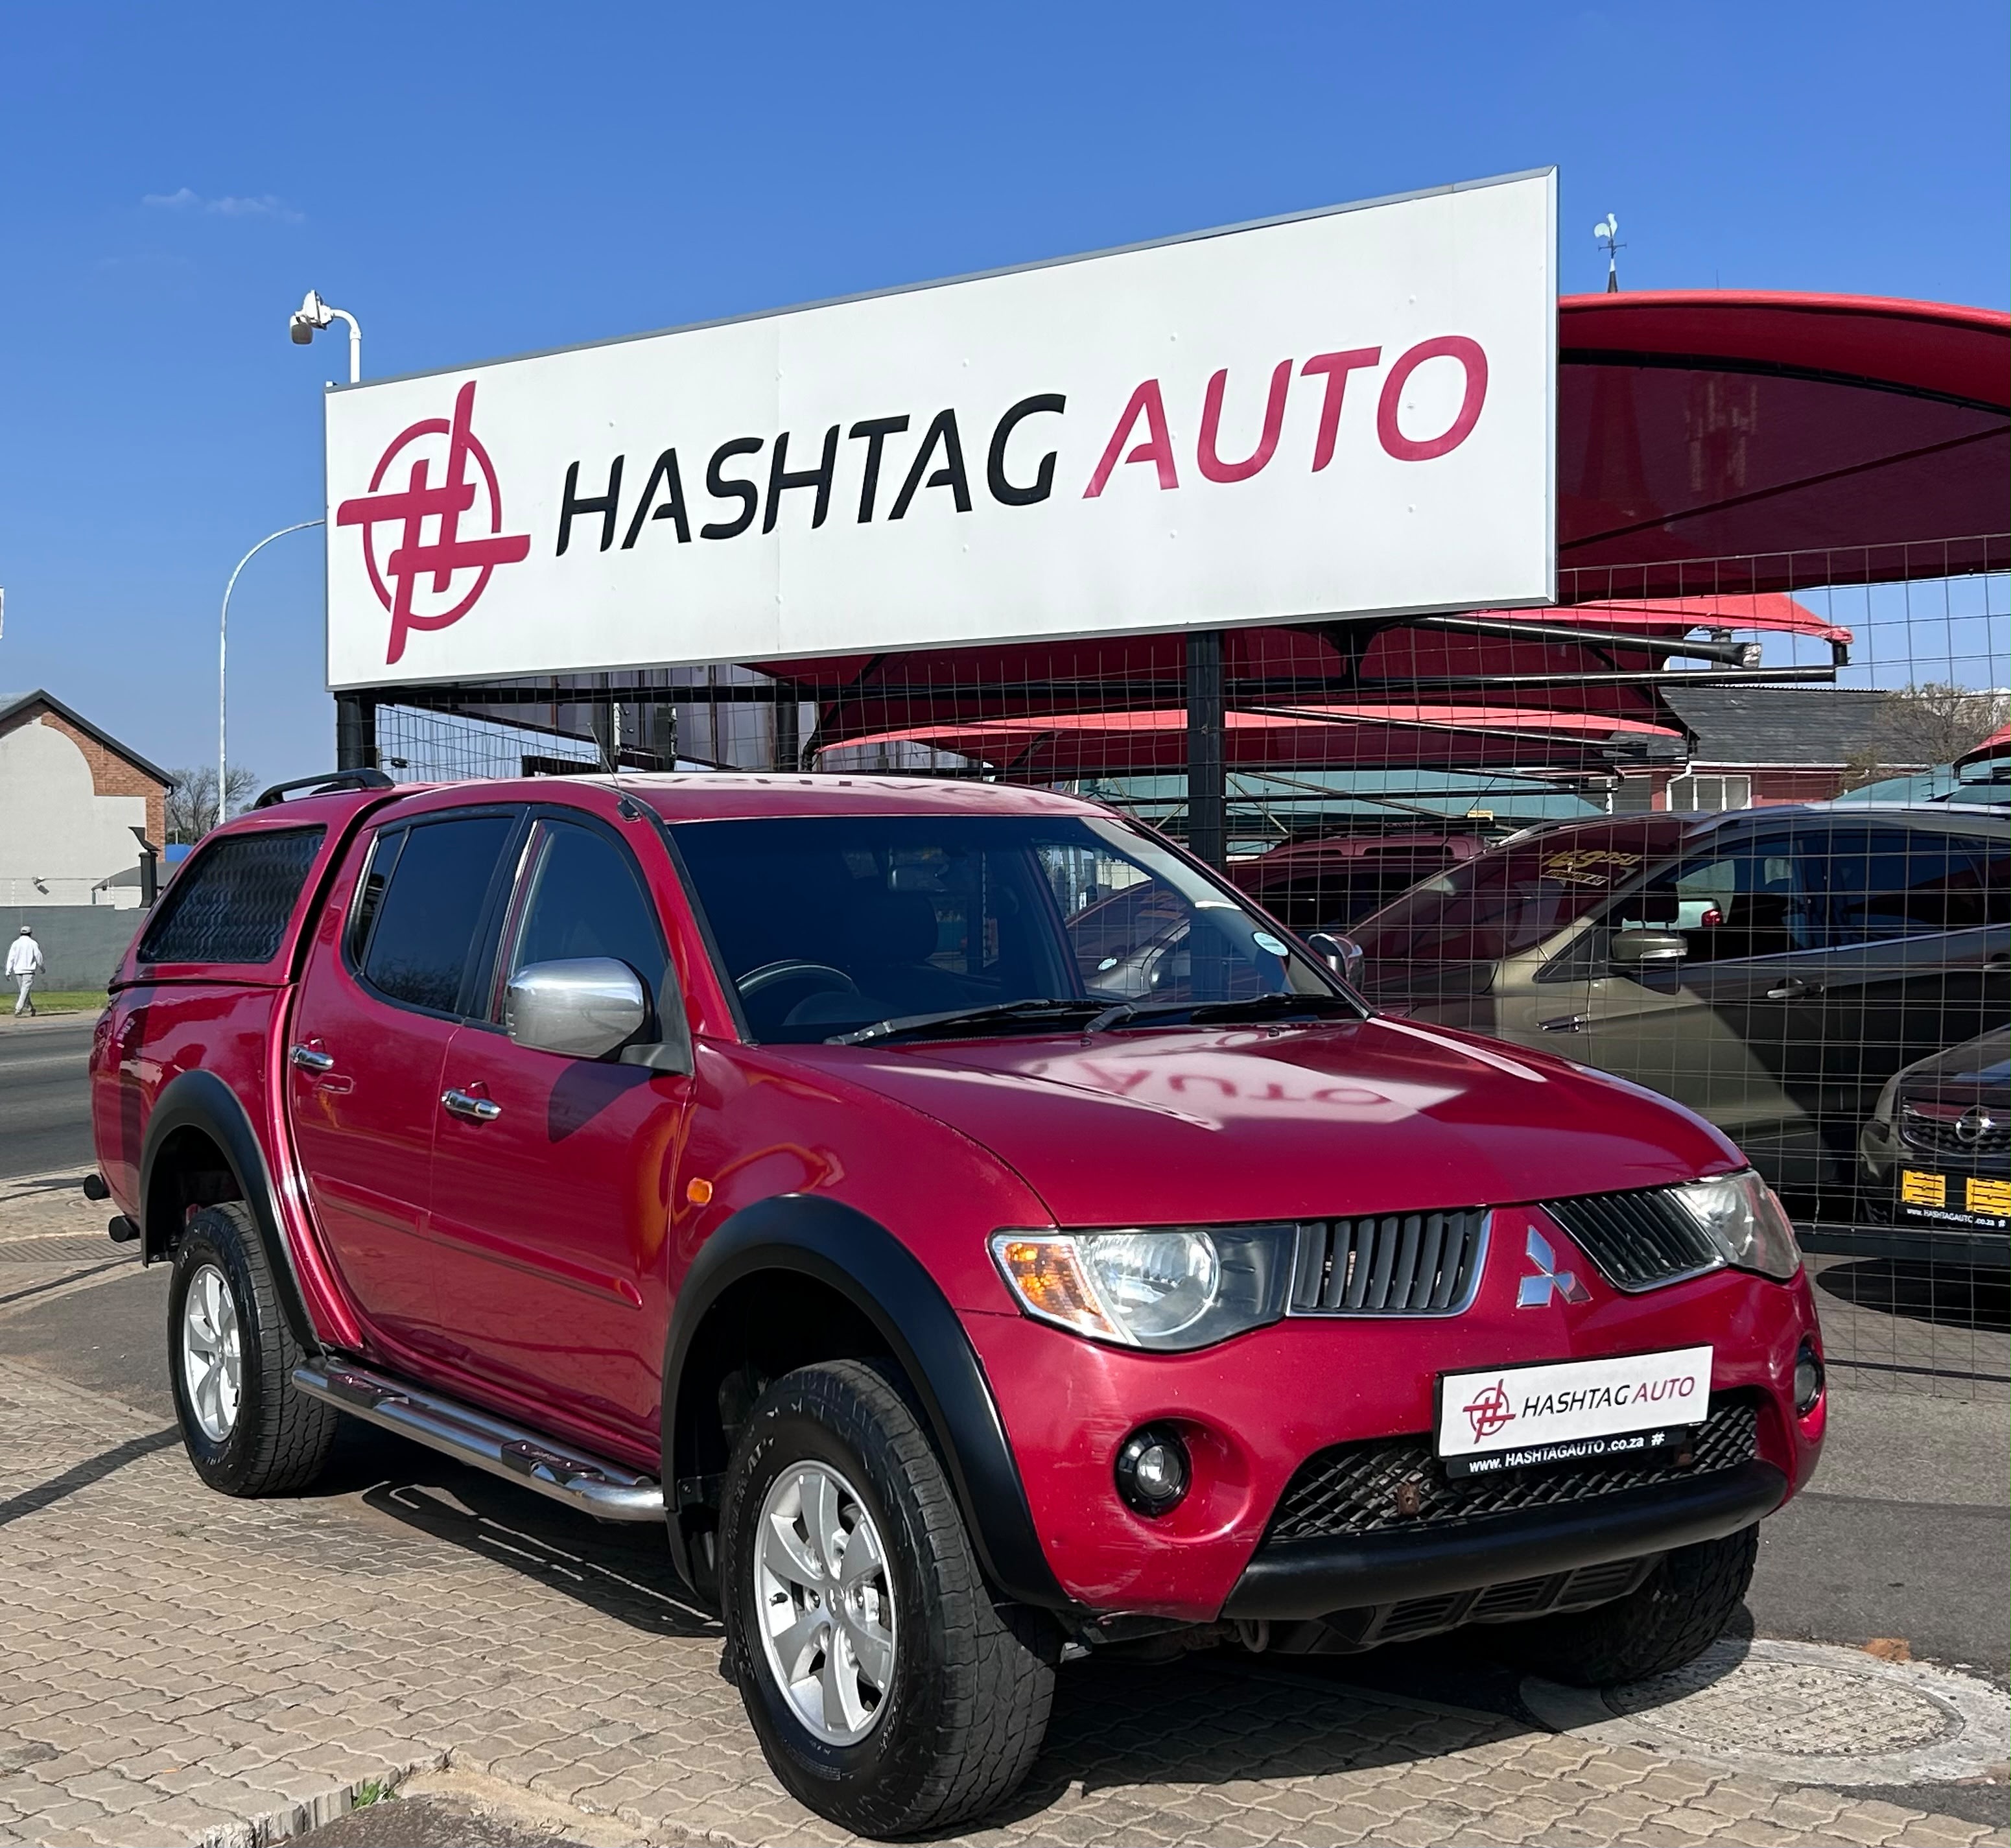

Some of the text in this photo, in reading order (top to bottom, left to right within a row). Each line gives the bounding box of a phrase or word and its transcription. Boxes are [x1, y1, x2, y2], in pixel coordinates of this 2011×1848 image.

[556, 335, 1488, 556] HASHTAG AUTO
[1522, 1377, 1695, 1418] HASHTAG AUTO
[1469, 1458, 1502, 1473] www.
[1505, 1440, 1605, 1467] HASHTAGAUTO
